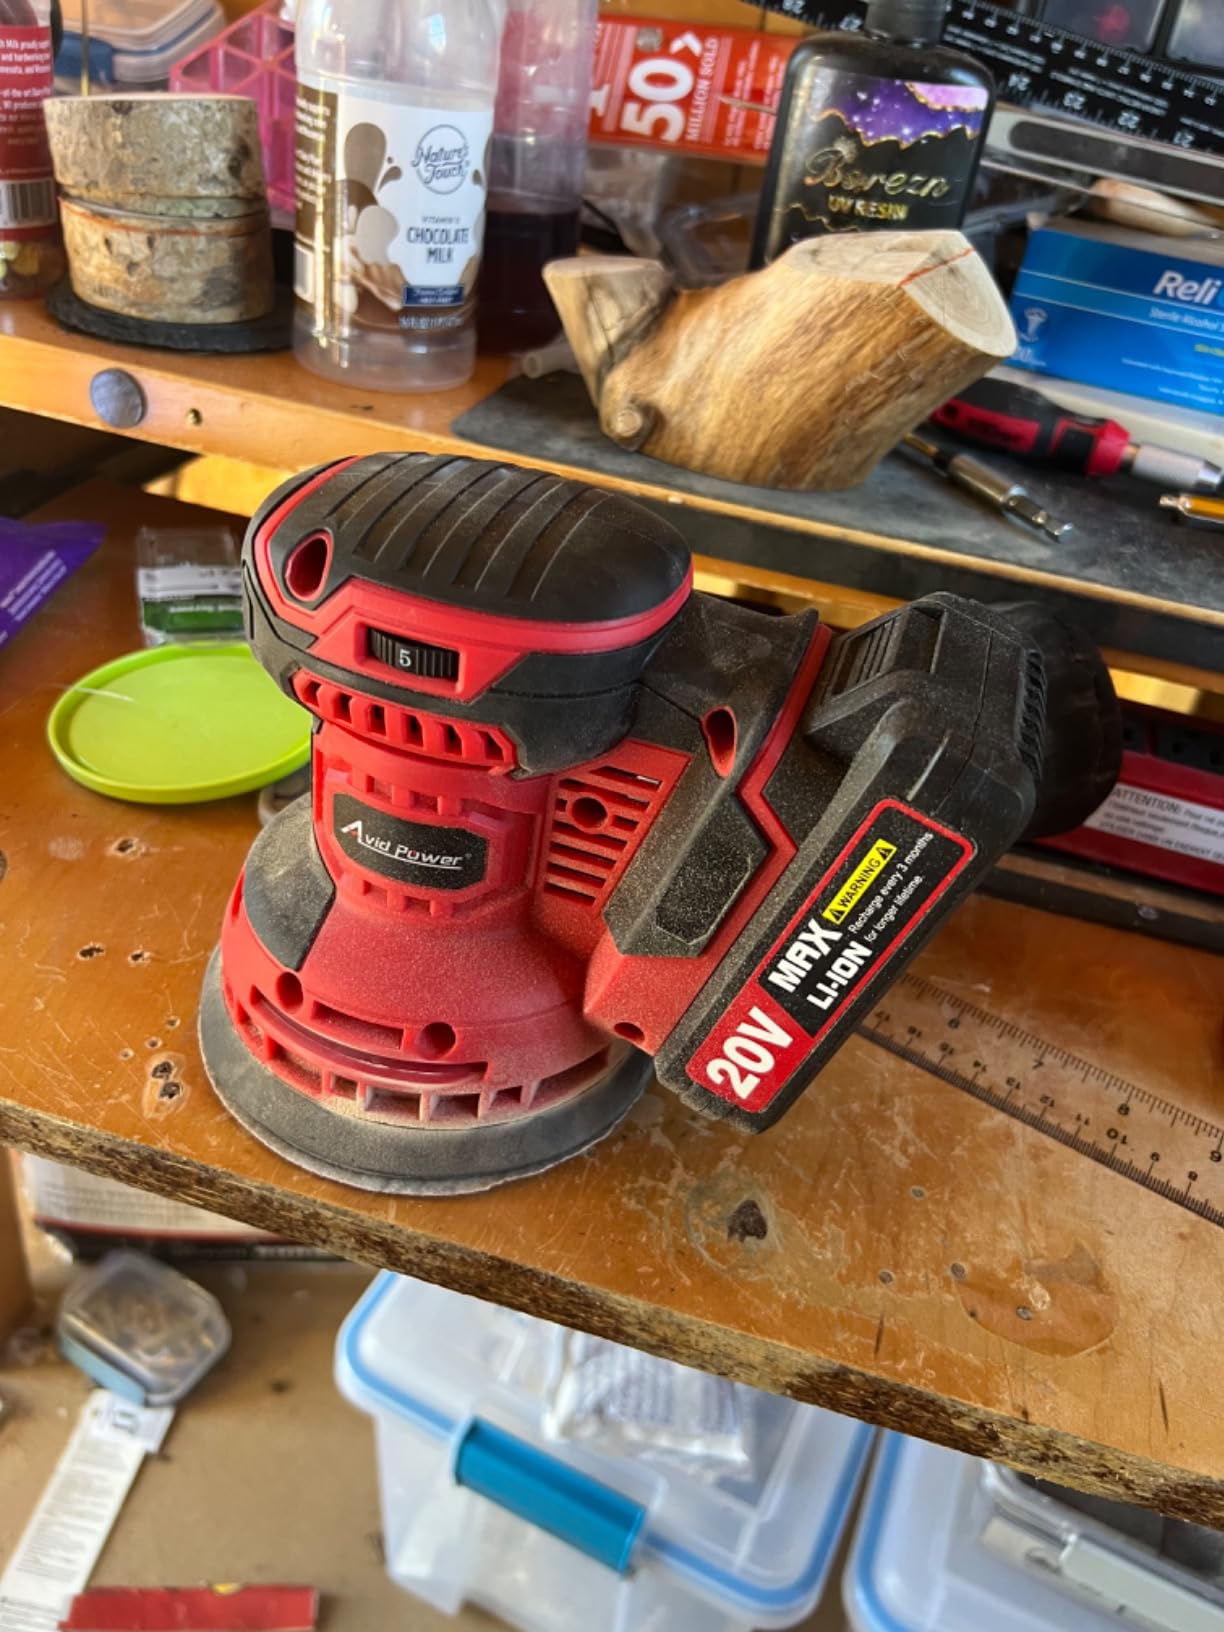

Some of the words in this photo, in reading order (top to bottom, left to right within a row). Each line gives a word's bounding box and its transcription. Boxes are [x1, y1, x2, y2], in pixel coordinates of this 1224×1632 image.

[684, 78, 712, 141] MILLION
[700, 37, 719, 77] SOLD
[1008, 73, 1031, 92] 24
[619, 58, 695, 142] 50
[1063, 91, 1085, 110] 23
[1118, 110, 1140, 129] 22
[411, 145, 469, 168] Nature's
[424, 165, 465, 185] Touch
[828, 194, 852, 213] UV
[854, 199, 909, 220] RESIN
[407, 227, 469, 246] CHOCOLATE
[426, 247, 454, 264] MILK
[399, 648, 412, 668] 5
[340, 819, 391, 852] Avid
[394, 844, 463, 867] Power
[839, 857, 881, 909] WARNING
[848, 893, 885, 934] Recharge
[879, 870, 904, 902] every
[896, 863, 908, 873] 3
[904, 831, 934, 867] months
[864, 929, 878, 943] for
[876, 904, 899, 933] longer
[767, 918, 843, 993] MAX
[806, 940, 873, 1011] LI-ION
[705, 1005, 794, 1100] 20V
[1038, 1095, 1056, 1108] 12
[1106, 1127, 1128, 1145] 10
